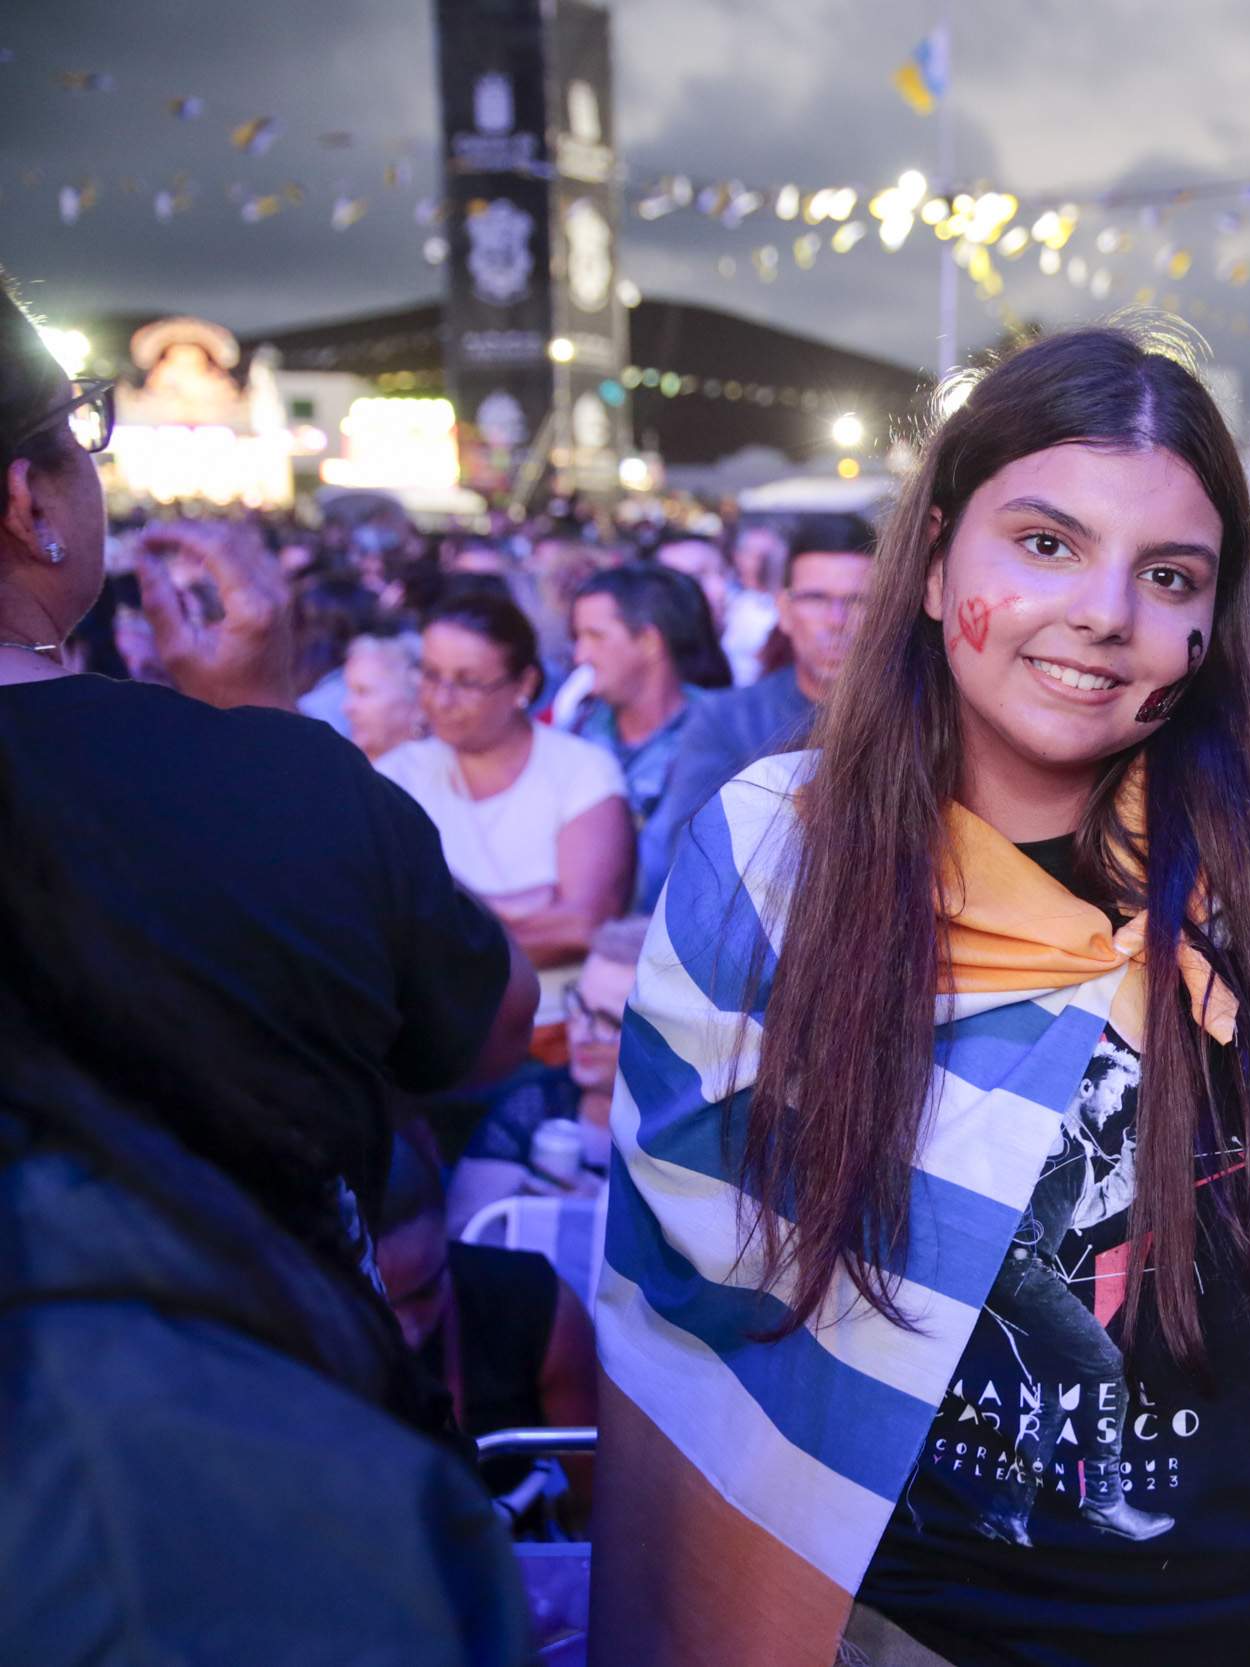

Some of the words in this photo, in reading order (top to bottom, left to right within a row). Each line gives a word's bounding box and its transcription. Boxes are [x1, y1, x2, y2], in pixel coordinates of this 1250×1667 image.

[936, 1404, 1199, 1444] ARASCO
[1098, 1457, 1179, 1476] TOUR
[1098, 1475, 1180, 1493] 2023
